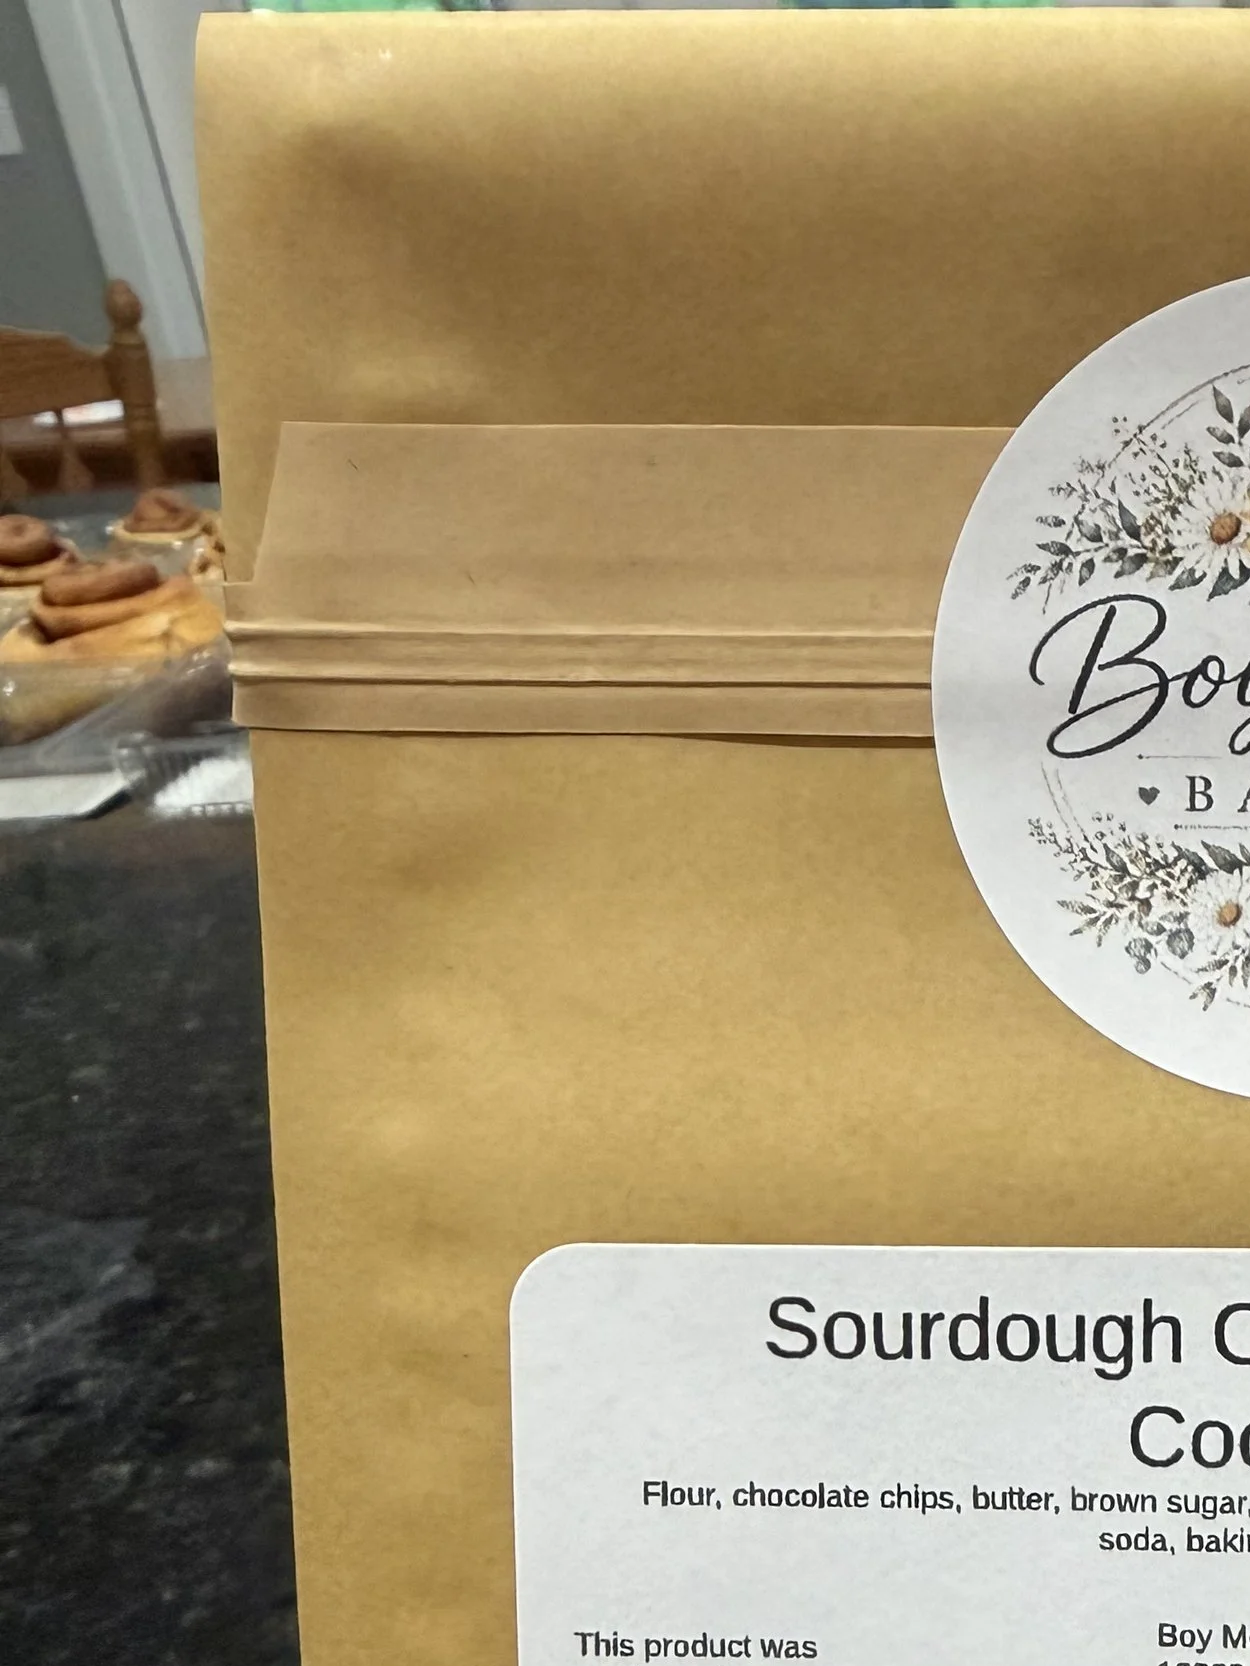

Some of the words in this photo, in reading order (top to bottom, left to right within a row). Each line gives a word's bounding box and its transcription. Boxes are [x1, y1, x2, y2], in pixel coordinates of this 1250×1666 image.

[764, 1294, 1183, 1383] Sourdough
[642, 1479, 723, 1512] Flour,
[731, 1479, 871, 1511] chocolate
[878, 1481, 963, 1517] chips,
[971, 1483, 1062, 1517] butter,
[1069, 1484, 1159, 1515] brown
[1097, 1524, 1177, 1557] soda,
[572, 1629, 636, 1659] This
[643, 1630, 753, 1665] product
[758, 1637, 819, 1660] was
[1156, 1621, 1214, 1656] Boy
